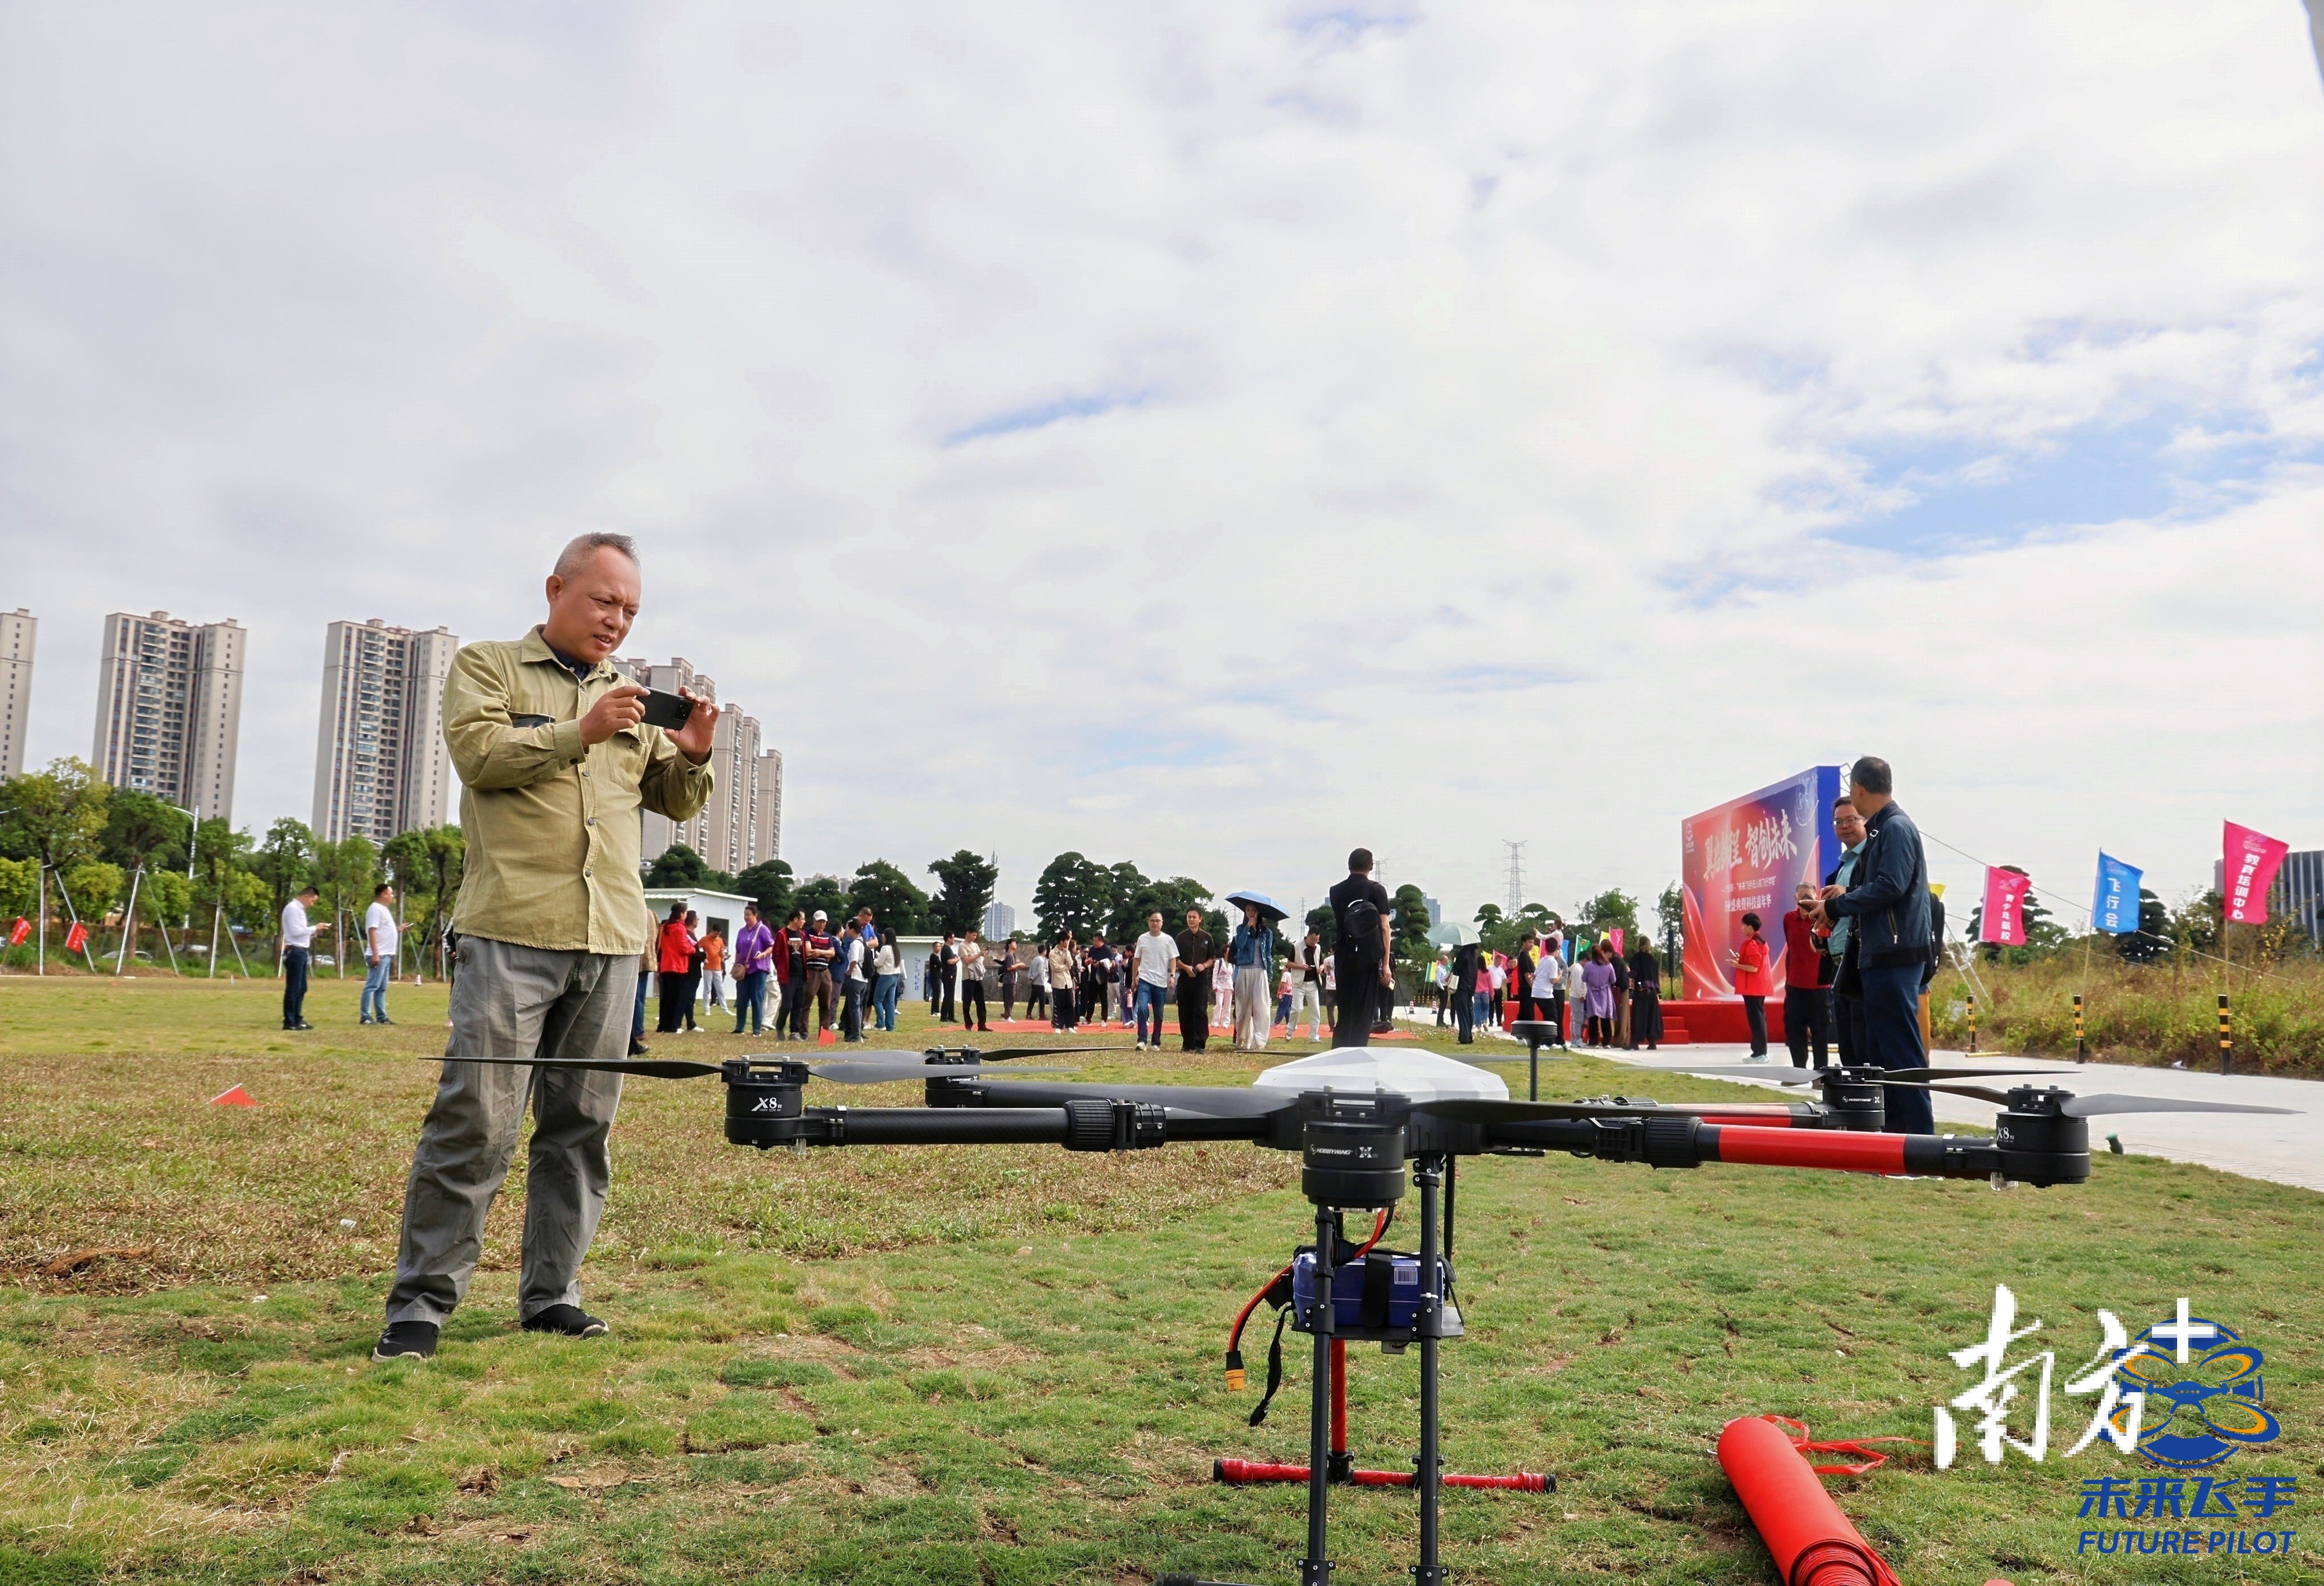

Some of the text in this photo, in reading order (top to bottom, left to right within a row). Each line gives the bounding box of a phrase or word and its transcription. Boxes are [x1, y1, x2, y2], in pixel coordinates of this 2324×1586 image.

[1745, 809, 1797, 871] 智创未来
[2106, 877, 2121, 928] 飞行会
[2231, 853, 2260, 920] 教育培训中心
[1316, 1147, 1351, 1156] HOBBYWING
